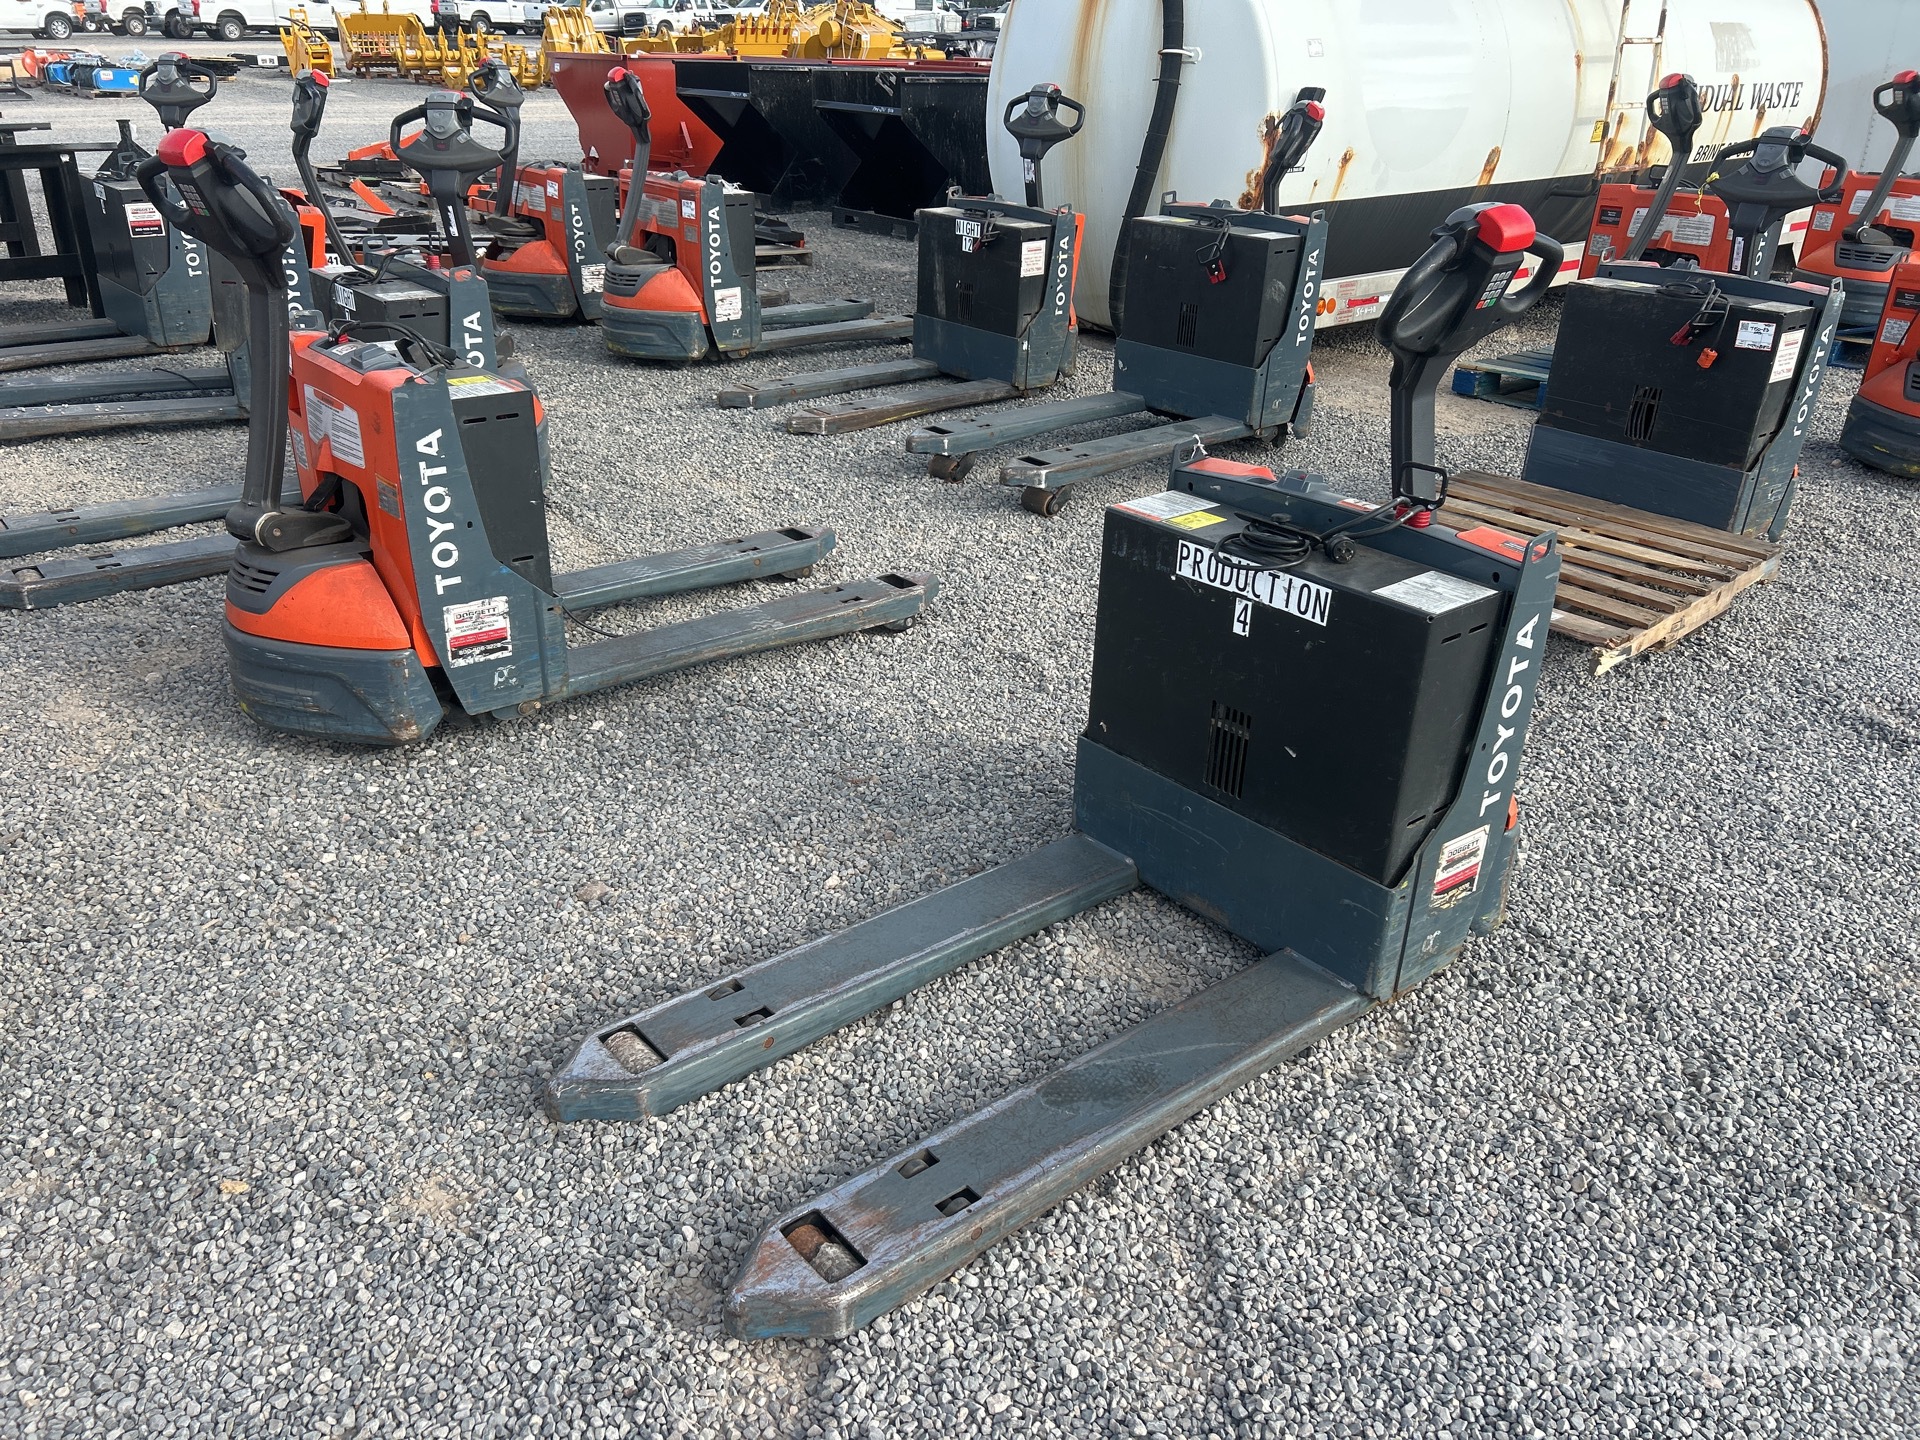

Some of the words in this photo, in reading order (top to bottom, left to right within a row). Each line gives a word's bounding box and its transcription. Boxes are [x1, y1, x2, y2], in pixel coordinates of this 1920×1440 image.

[1698, 83, 1745, 113] IDUAL
[1750, 82, 1803, 110] WASTE
[956, 219, 981, 237] NIGHT
[708, 206, 722, 288] TOYOTA
[963, 238, 973, 252] 12
[335, 284, 356, 311] NIGHT
[1296, 248, 1320, 347] TOYOTA
[416, 428, 463, 596] TOYOTA
[1178, 542, 1331, 624] PRODUCTION
[1236, 603, 1249, 633] 4
[1480, 612, 1540, 818] TOYOTA
[1447, 839, 1480, 858] DOGGETT
